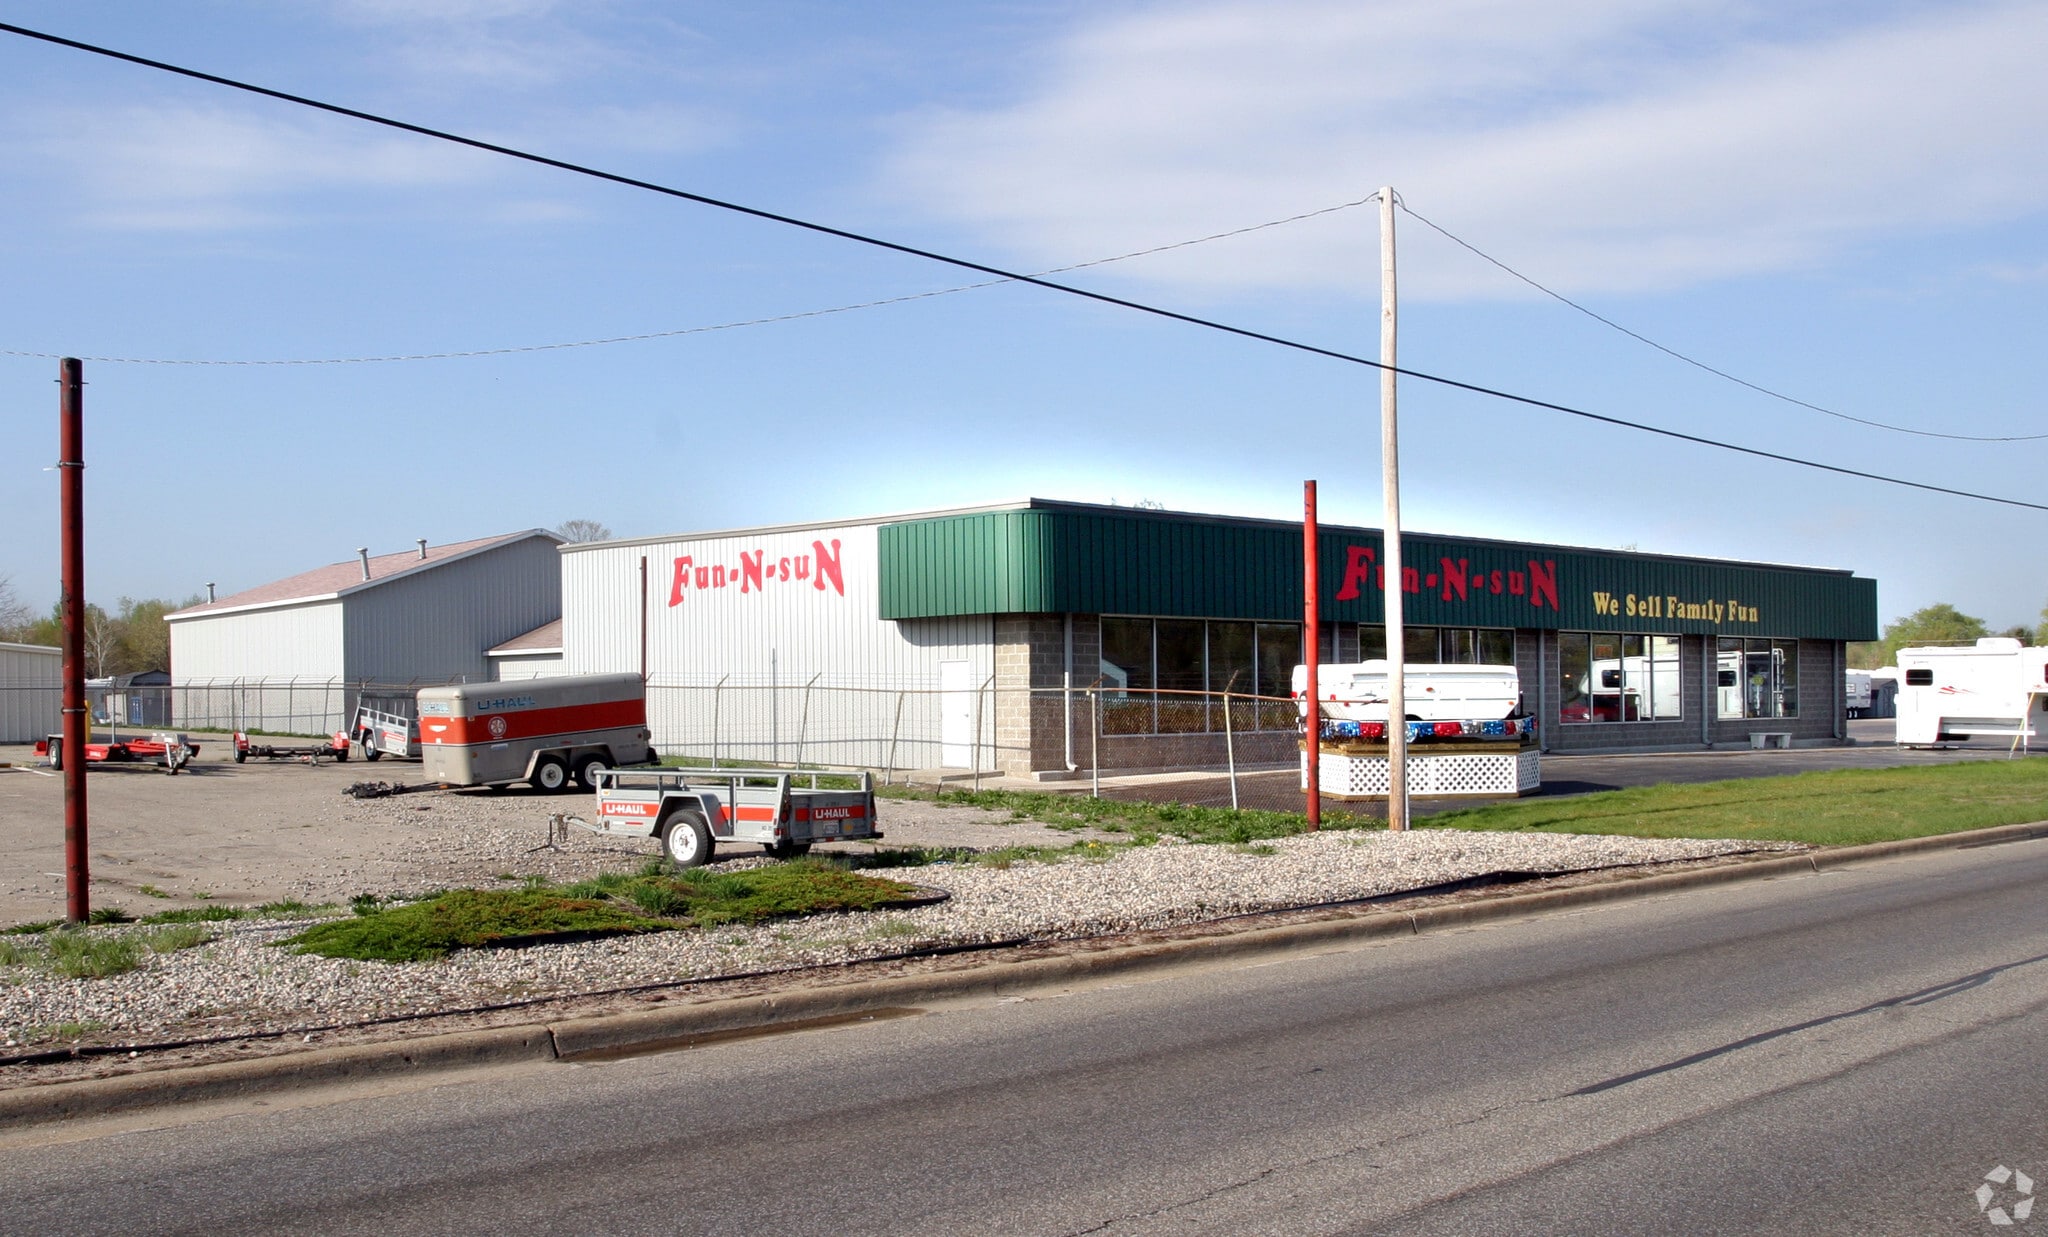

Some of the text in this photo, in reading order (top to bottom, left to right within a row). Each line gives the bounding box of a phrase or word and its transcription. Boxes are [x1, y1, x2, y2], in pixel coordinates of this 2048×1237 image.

[1593, 591, 1759, 624] We Sell Family Fun
[606, 804, 647, 815] U-HAUL
[815, 807, 851, 819] U-HAUL
